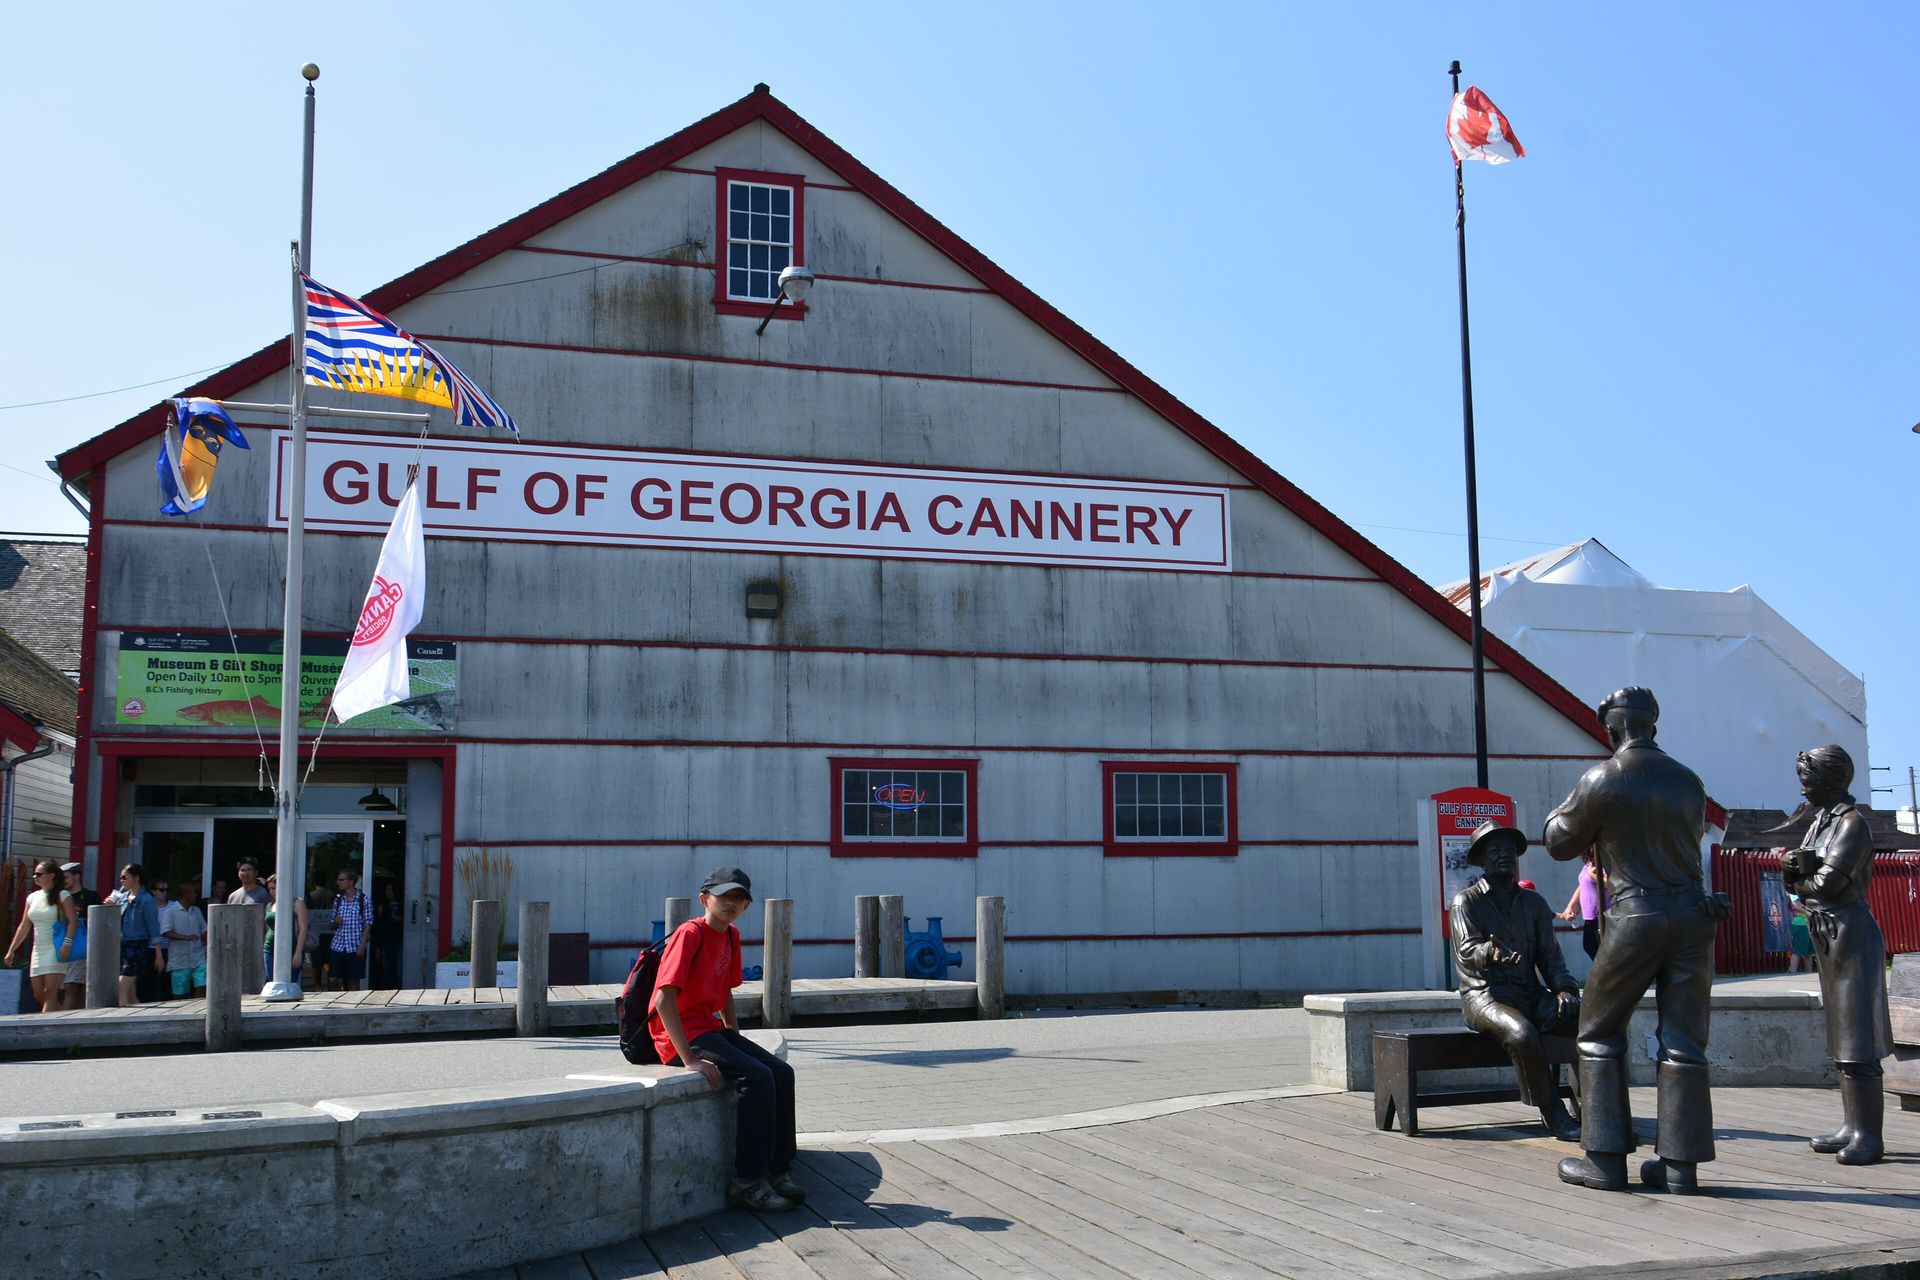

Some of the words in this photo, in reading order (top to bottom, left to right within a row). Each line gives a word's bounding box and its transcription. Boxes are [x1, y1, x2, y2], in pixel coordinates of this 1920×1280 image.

[322, 459, 501, 511] GULF
[523, 471, 608, 517] OF
[630, 477, 911, 533] GEORGIA
[926, 494, 1193, 547] CANNERY
[417, 647, 443, 655] Canada
[147, 657, 206, 670] Museum
[209, 659, 219, 671] &
[222, 659, 246, 671] Gift
[250, 660, 283, 674] Shop
[147, 671, 176, 683] Open
[180, 672, 207, 684] Daily
[211, 673, 240, 682] 10am
[244, 674, 256, 684] to
[258, 674, 281, 685] 5pm
[301, 675, 339, 685] Ouvert
[166, 686, 193, 695] Fishing
[195, 687, 222, 696] History
[301, 687, 313, 696] de
[878, 788, 926, 802] OPEN
[1439, 803, 1460, 815] GULF
[1462, 803, 1472, 815] OF
[1474, 804, 1507, 816] GEORGIA
[1455, 816, 1492, 828] CANNER
